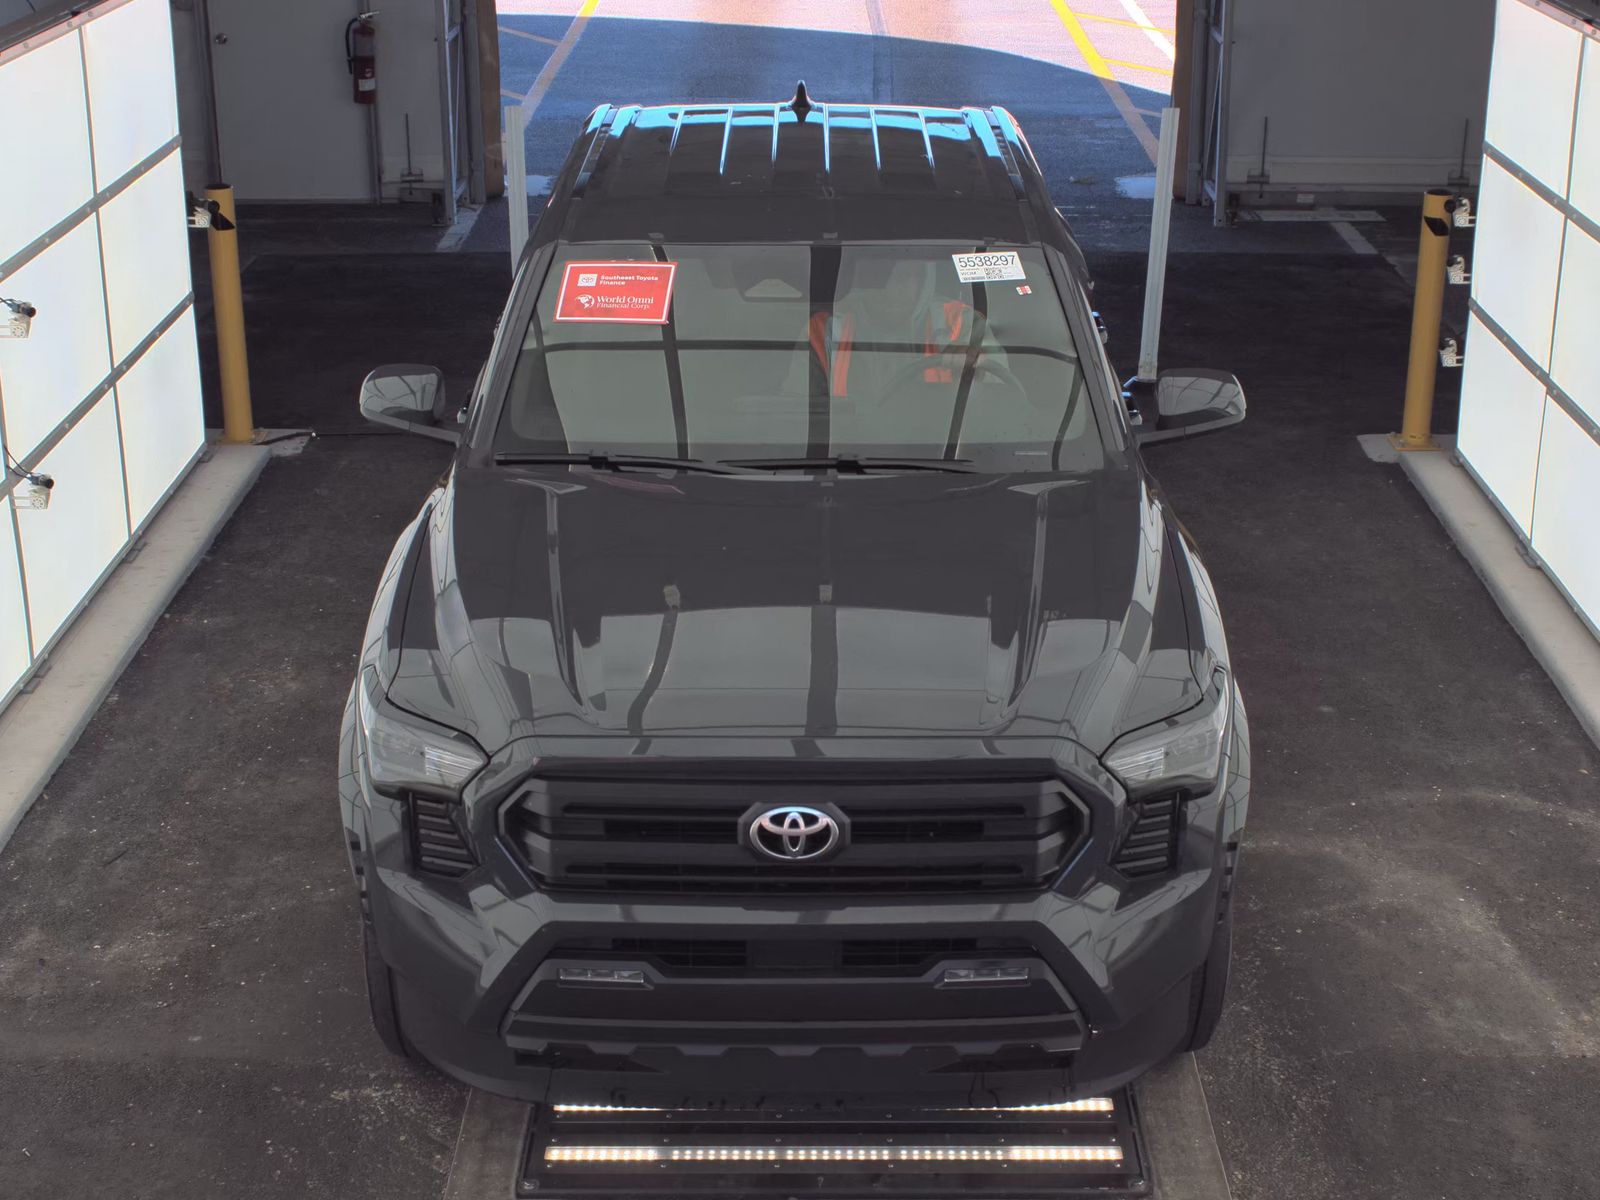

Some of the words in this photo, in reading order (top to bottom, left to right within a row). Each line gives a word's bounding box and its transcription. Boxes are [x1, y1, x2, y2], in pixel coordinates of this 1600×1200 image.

[958, 255, 1015, 268] 5538297
[597, 295, 626, 304] World
[627, 296, 654, 304] Omni
